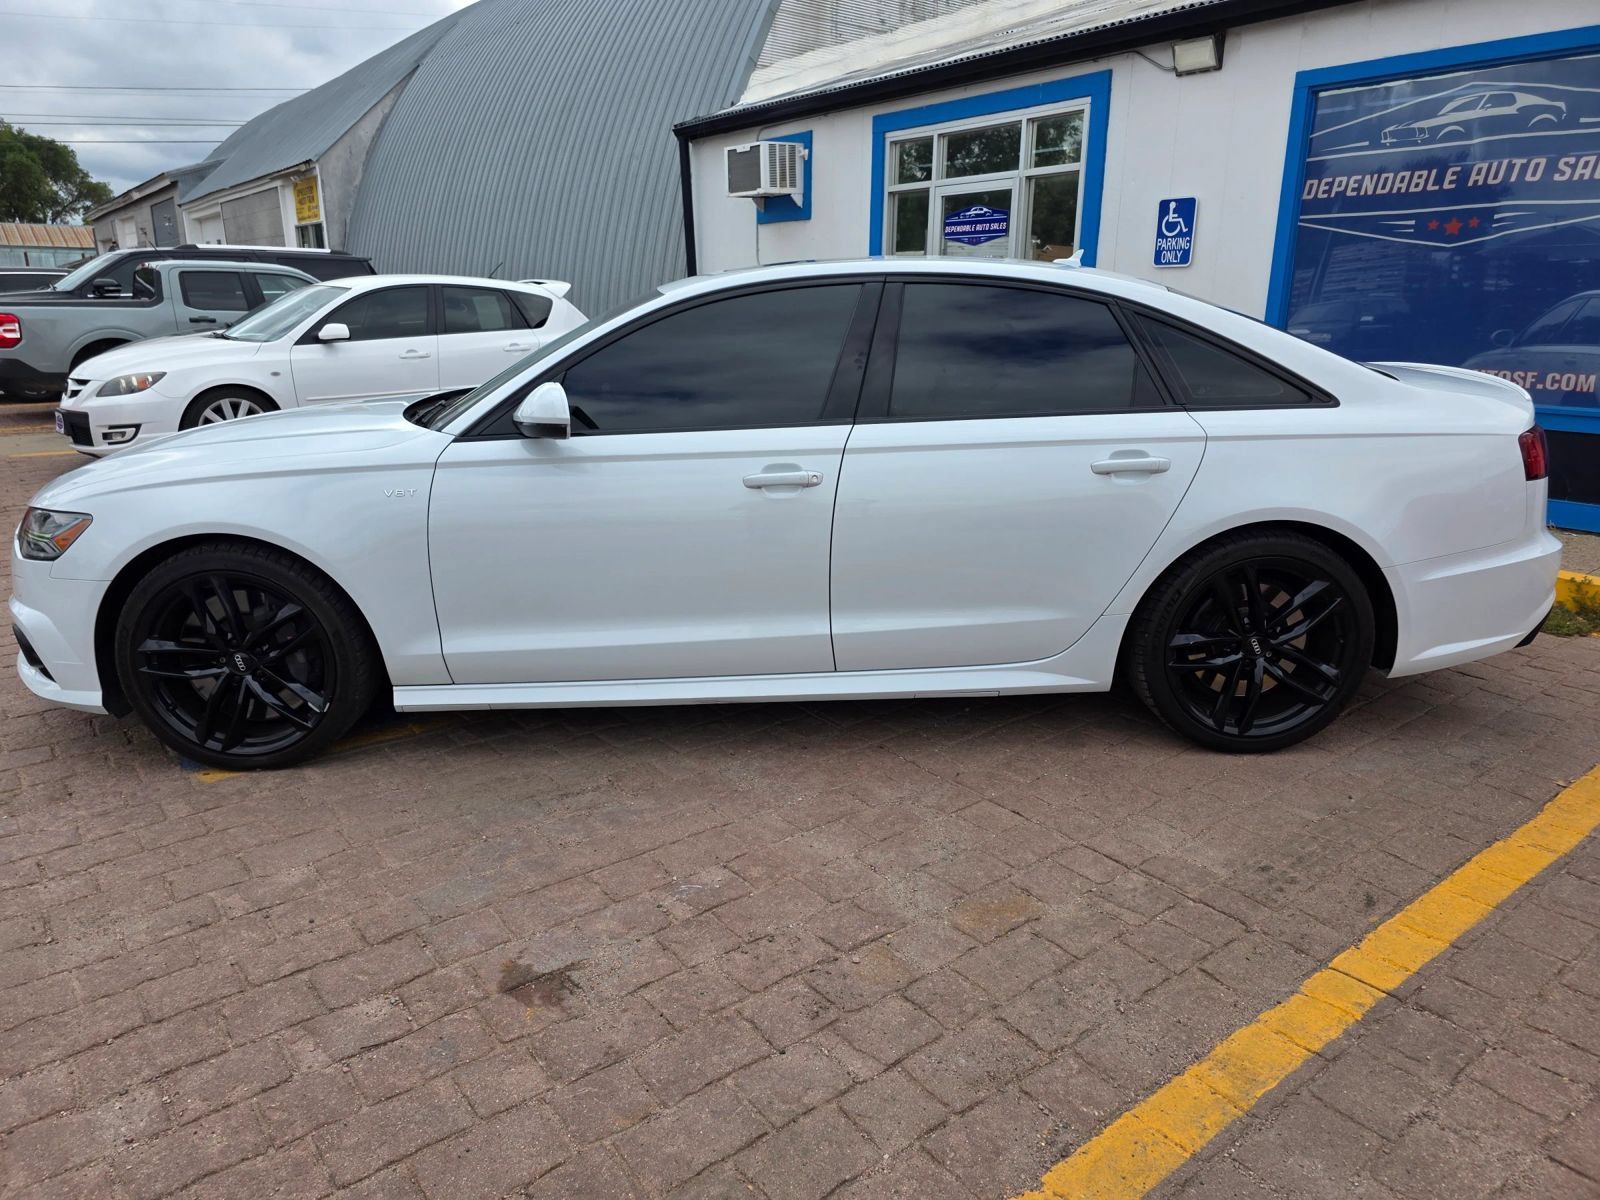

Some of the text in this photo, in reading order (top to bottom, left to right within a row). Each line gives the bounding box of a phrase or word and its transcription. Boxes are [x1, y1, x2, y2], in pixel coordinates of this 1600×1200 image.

[1302, 166, 1461, 200] DEPENDABLE
[1467, 158, 1547, 187] AUTO
[945, 222, 1007, 233] DEPENDABLE AUTO SALES
[1156, 237, 1190, 250] PARKING
[1161, 250, 1183, 263] ONLY
